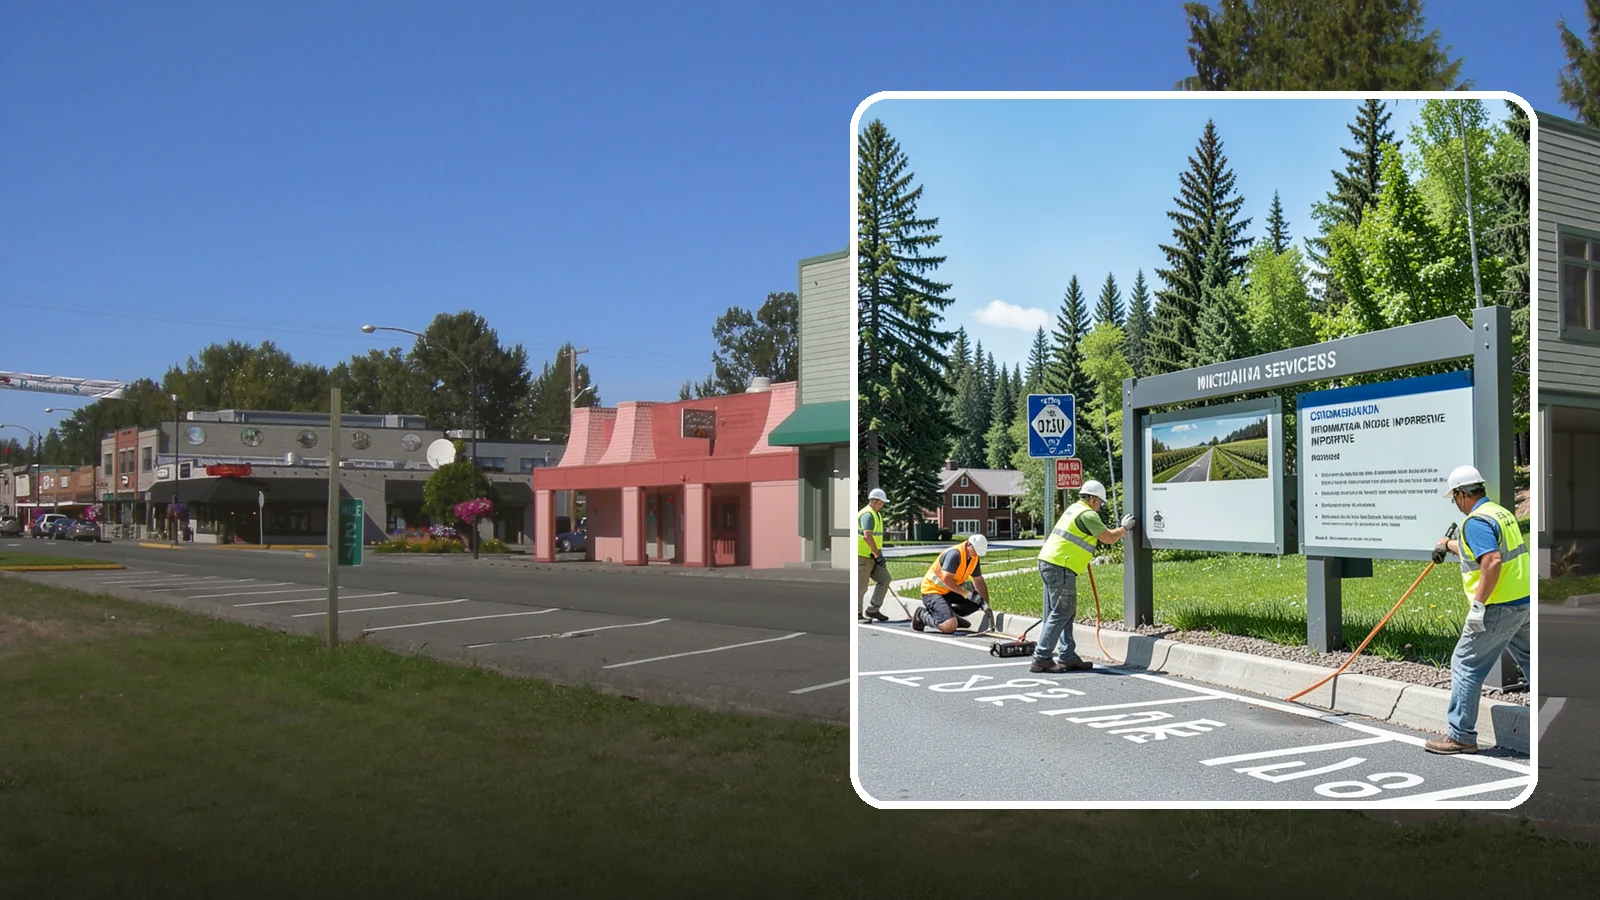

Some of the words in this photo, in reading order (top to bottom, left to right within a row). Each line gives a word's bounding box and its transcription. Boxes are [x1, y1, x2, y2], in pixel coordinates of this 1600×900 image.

[20, 379, 57, 392] Railroad
[341, 505, 362, 517] MILE
[345, 522, 357, 539] 2
[344, 543, 356, 559] 7
